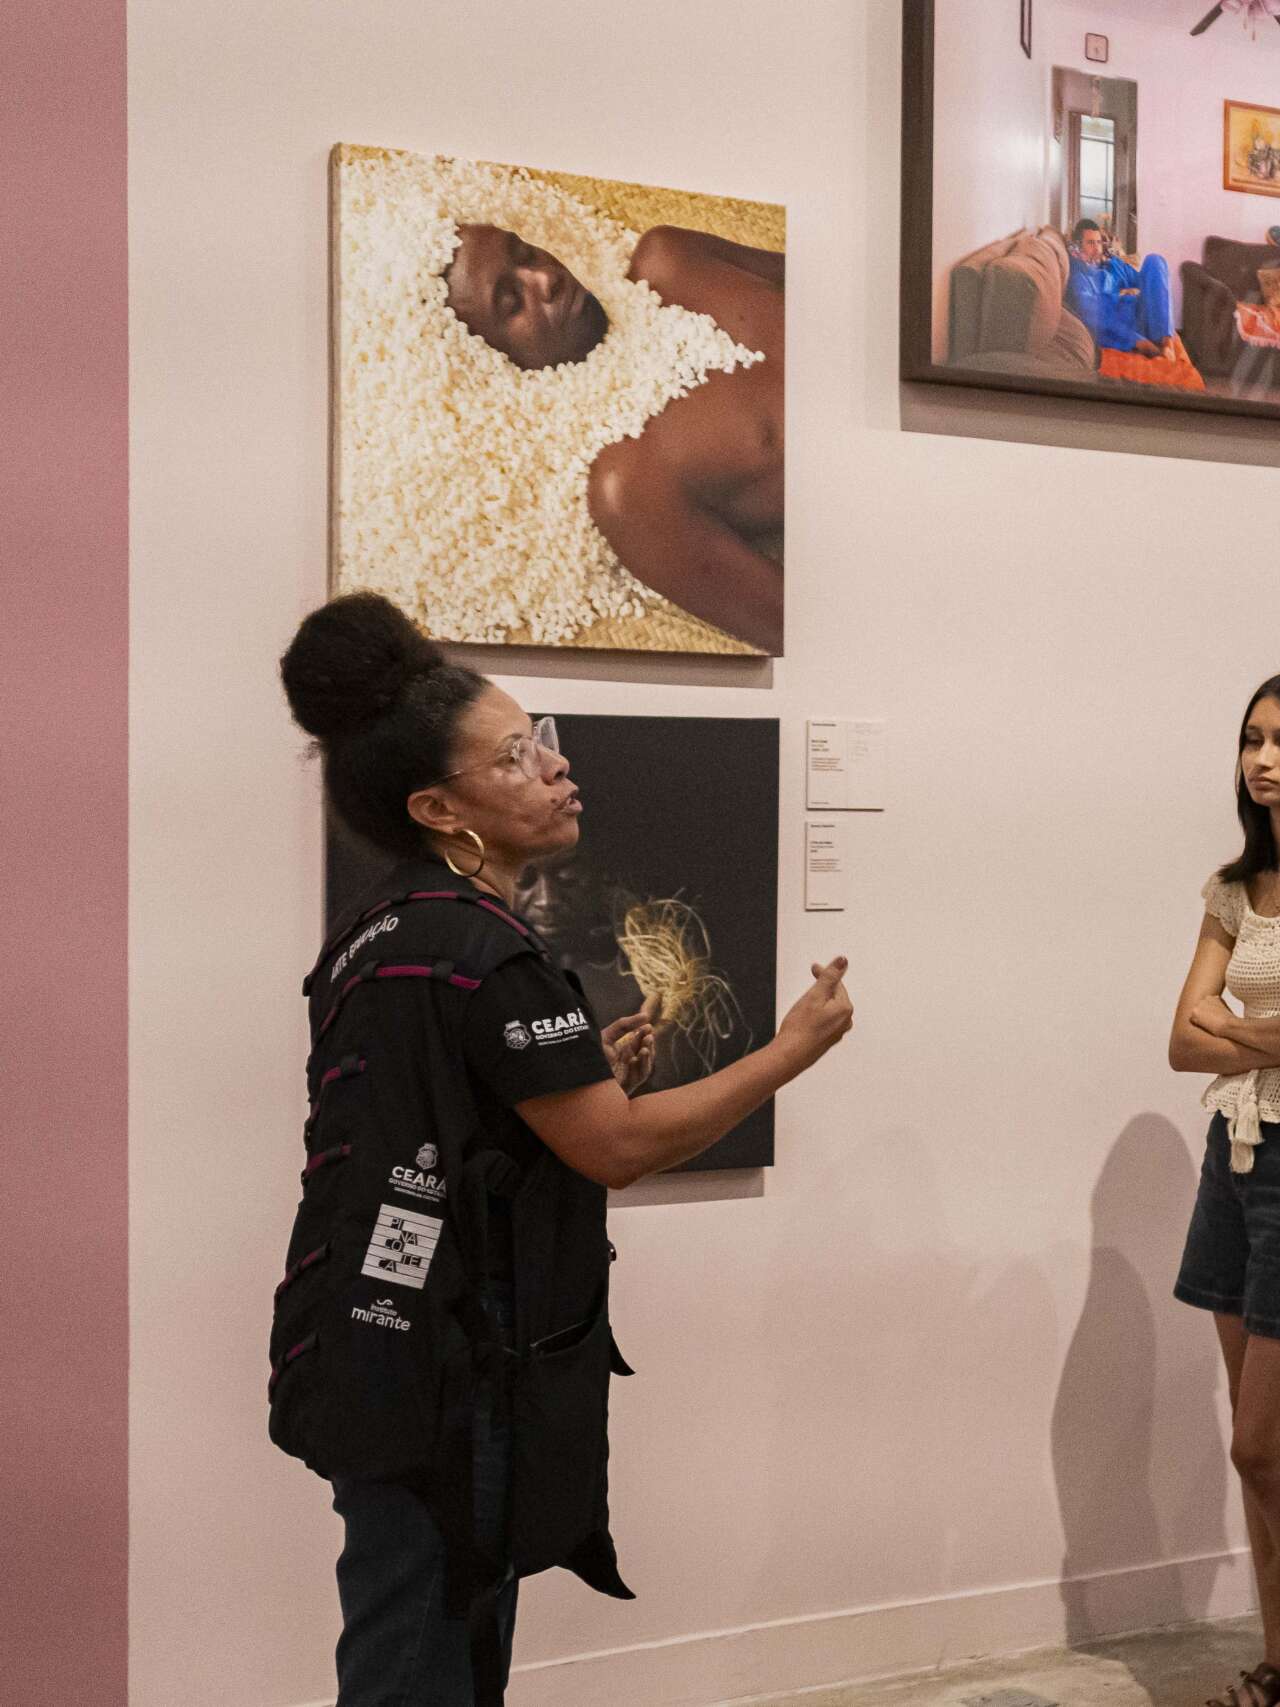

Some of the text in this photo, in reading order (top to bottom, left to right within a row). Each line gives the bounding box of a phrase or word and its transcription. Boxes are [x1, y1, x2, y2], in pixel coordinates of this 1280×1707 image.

[330, 951, 348, 984] ARTE
[531, 1007, 588, 1034] CEARÁ
[390, 1217, 404, 1230] PI
[384, 1237, 402, 1253] CO
[400, 1229, 418, 1246] NA
[401, 1255, 421, 1268] TE
[351, 1306, 411, 1331] mirante
